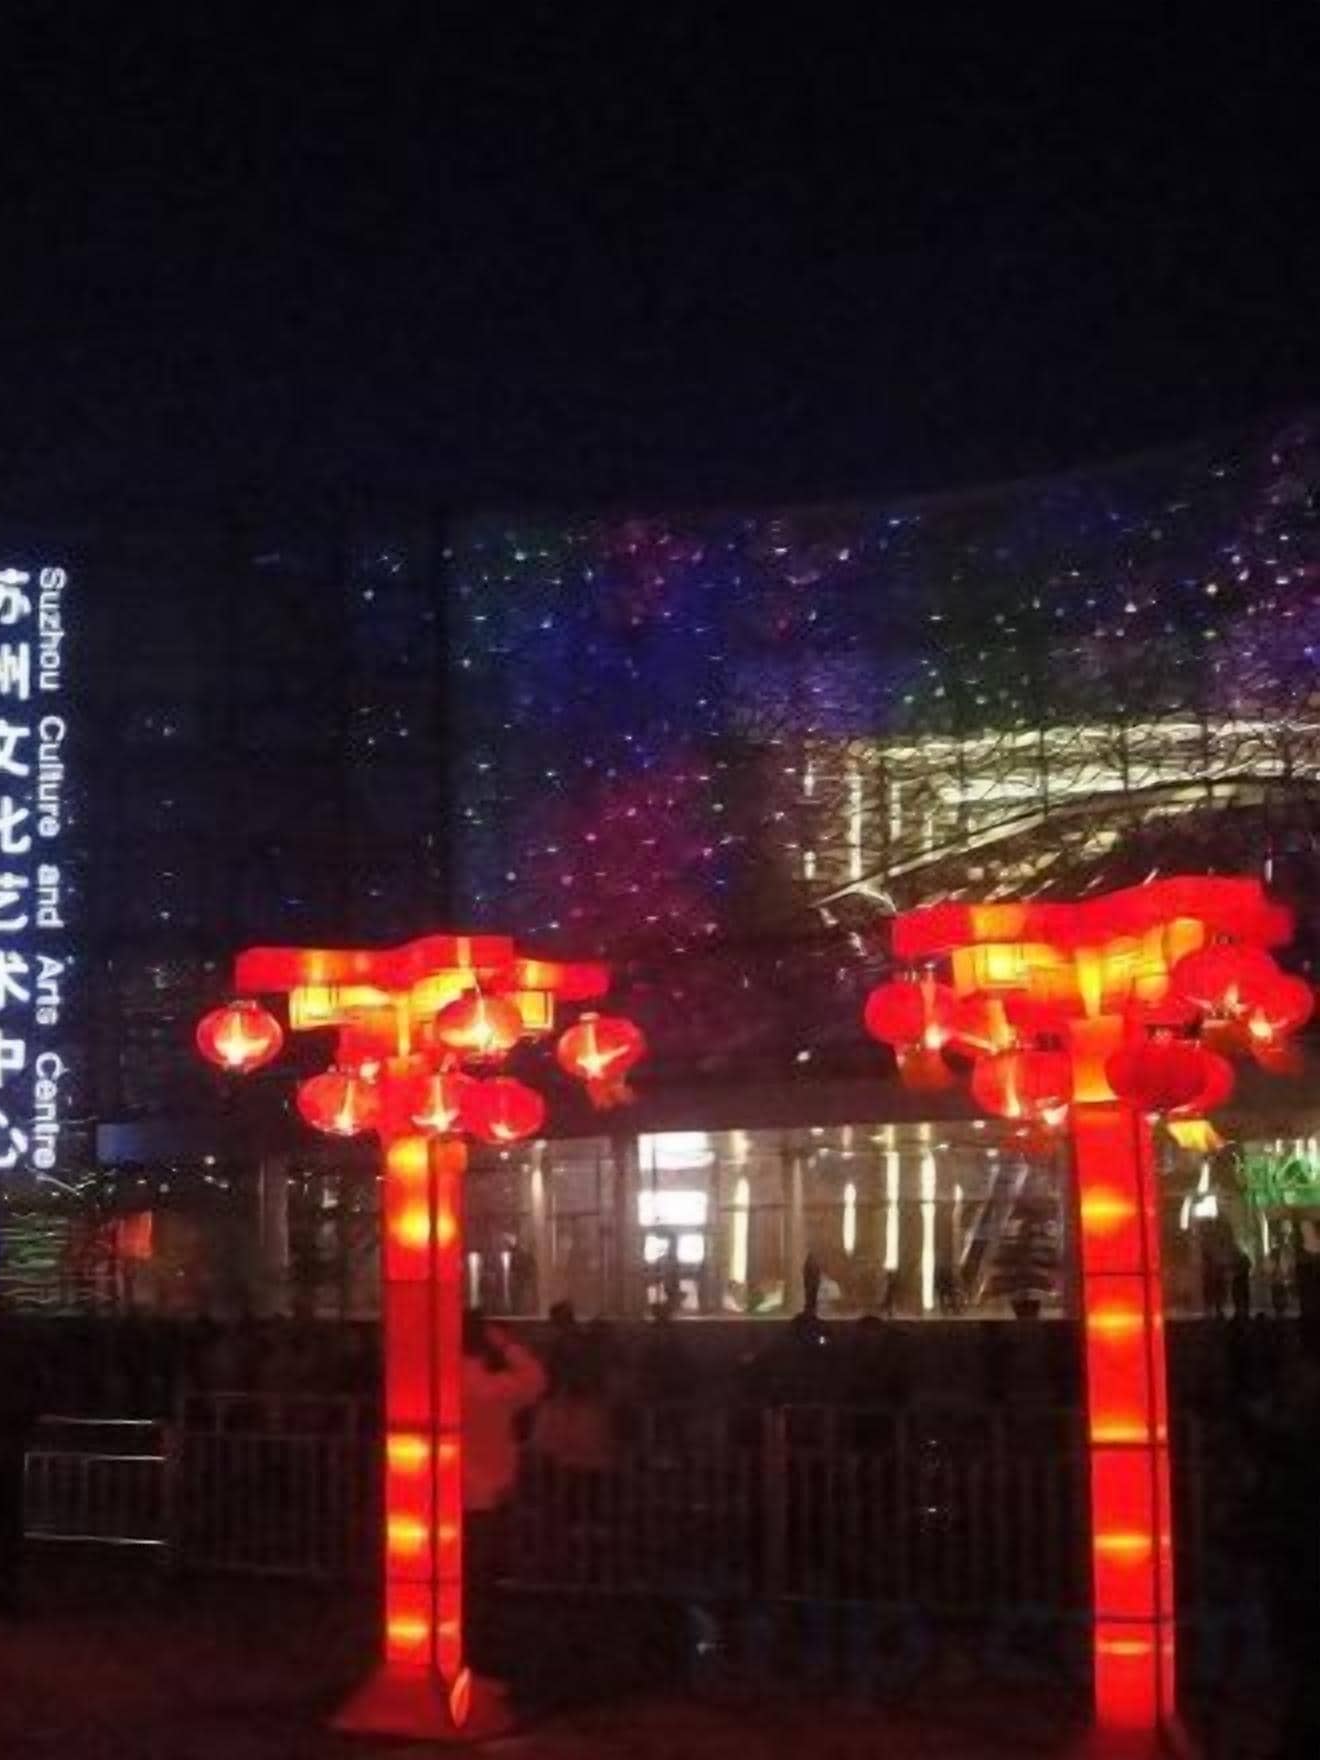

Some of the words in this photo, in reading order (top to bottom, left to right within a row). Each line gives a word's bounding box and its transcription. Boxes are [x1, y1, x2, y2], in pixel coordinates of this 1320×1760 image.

[38, 567, 67, 690] Suzhou
[37, 715, 66, 837] Culture
[36, 864, 64, 928] and
[35, 955, 65, 1025] Arts
[33, 1052, 62, 1169] Centre
